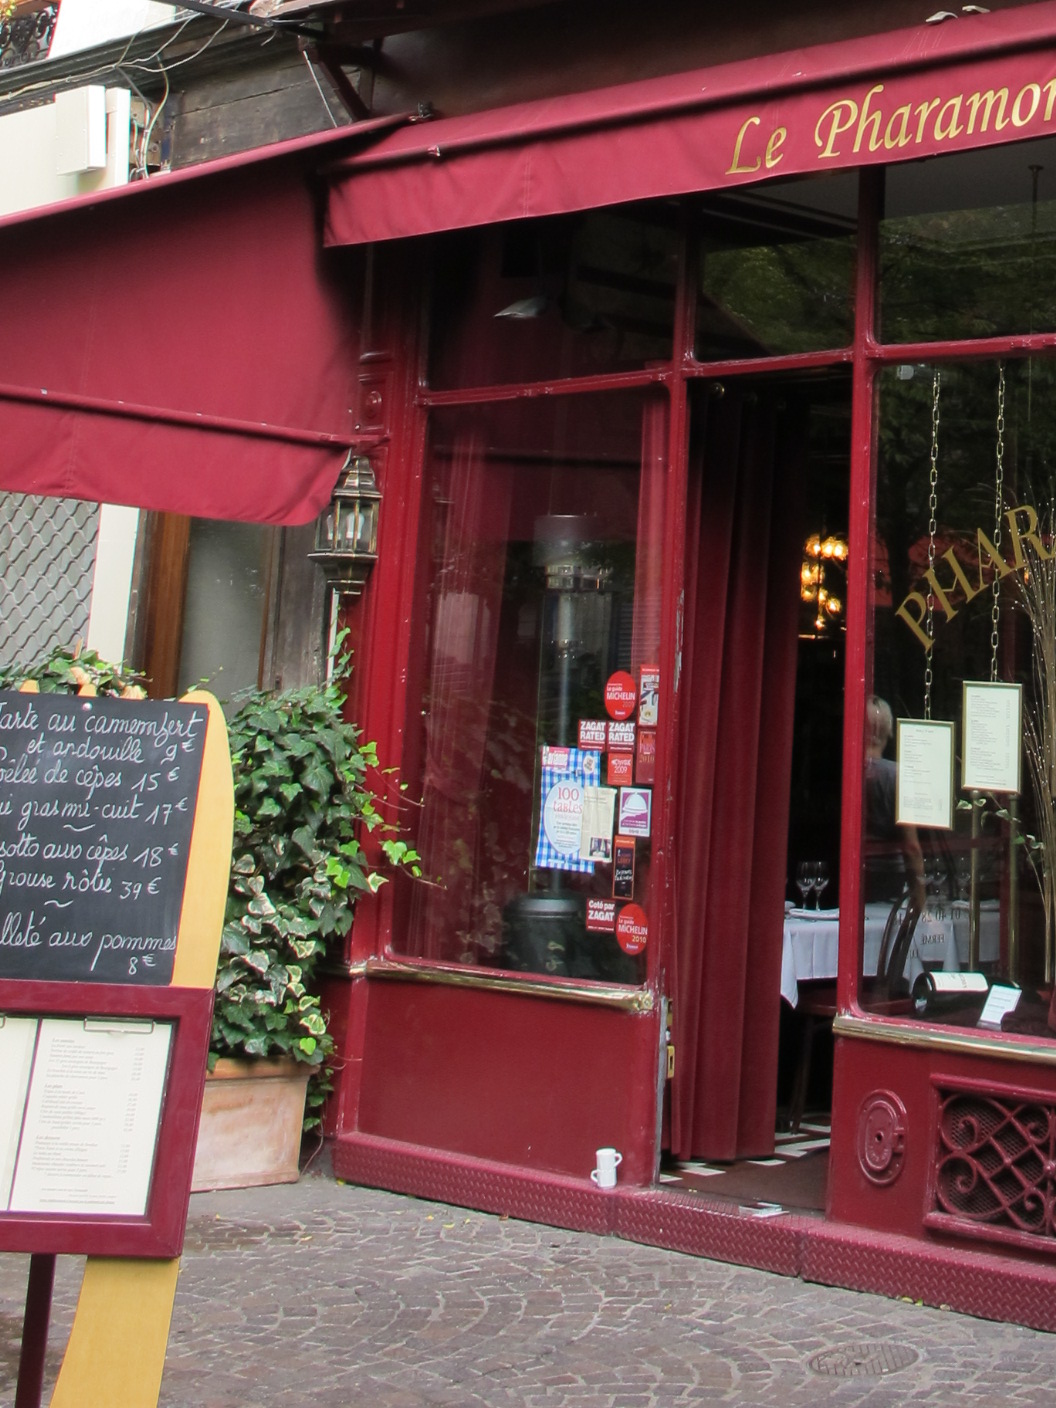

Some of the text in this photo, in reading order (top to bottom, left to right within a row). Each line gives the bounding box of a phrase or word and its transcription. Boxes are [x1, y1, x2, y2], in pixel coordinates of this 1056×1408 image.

[725, 116, 787, 175] Le
[606, 692, 635, 701] MICHELIN
[48, 713, 77, 732] au
[580, 721, 606, 731] ZAGAT
[608, 722, 635, 732] ZAGAT
[580, 731, 606, 741] RATED
[608, 733, 635, 742] RATED
[27, 732, 46, 754] et
[53, 735, 145, 764] andouille
[44, 759, 69, 784] de
[558, 787, 580, 801] 100
[18, 799, 60, 832] gras
[588, 910, 615, 922] ZAGAT
[618, 924, 648, 936] MICHELIN
[90, 933, 177, 973] pommes
